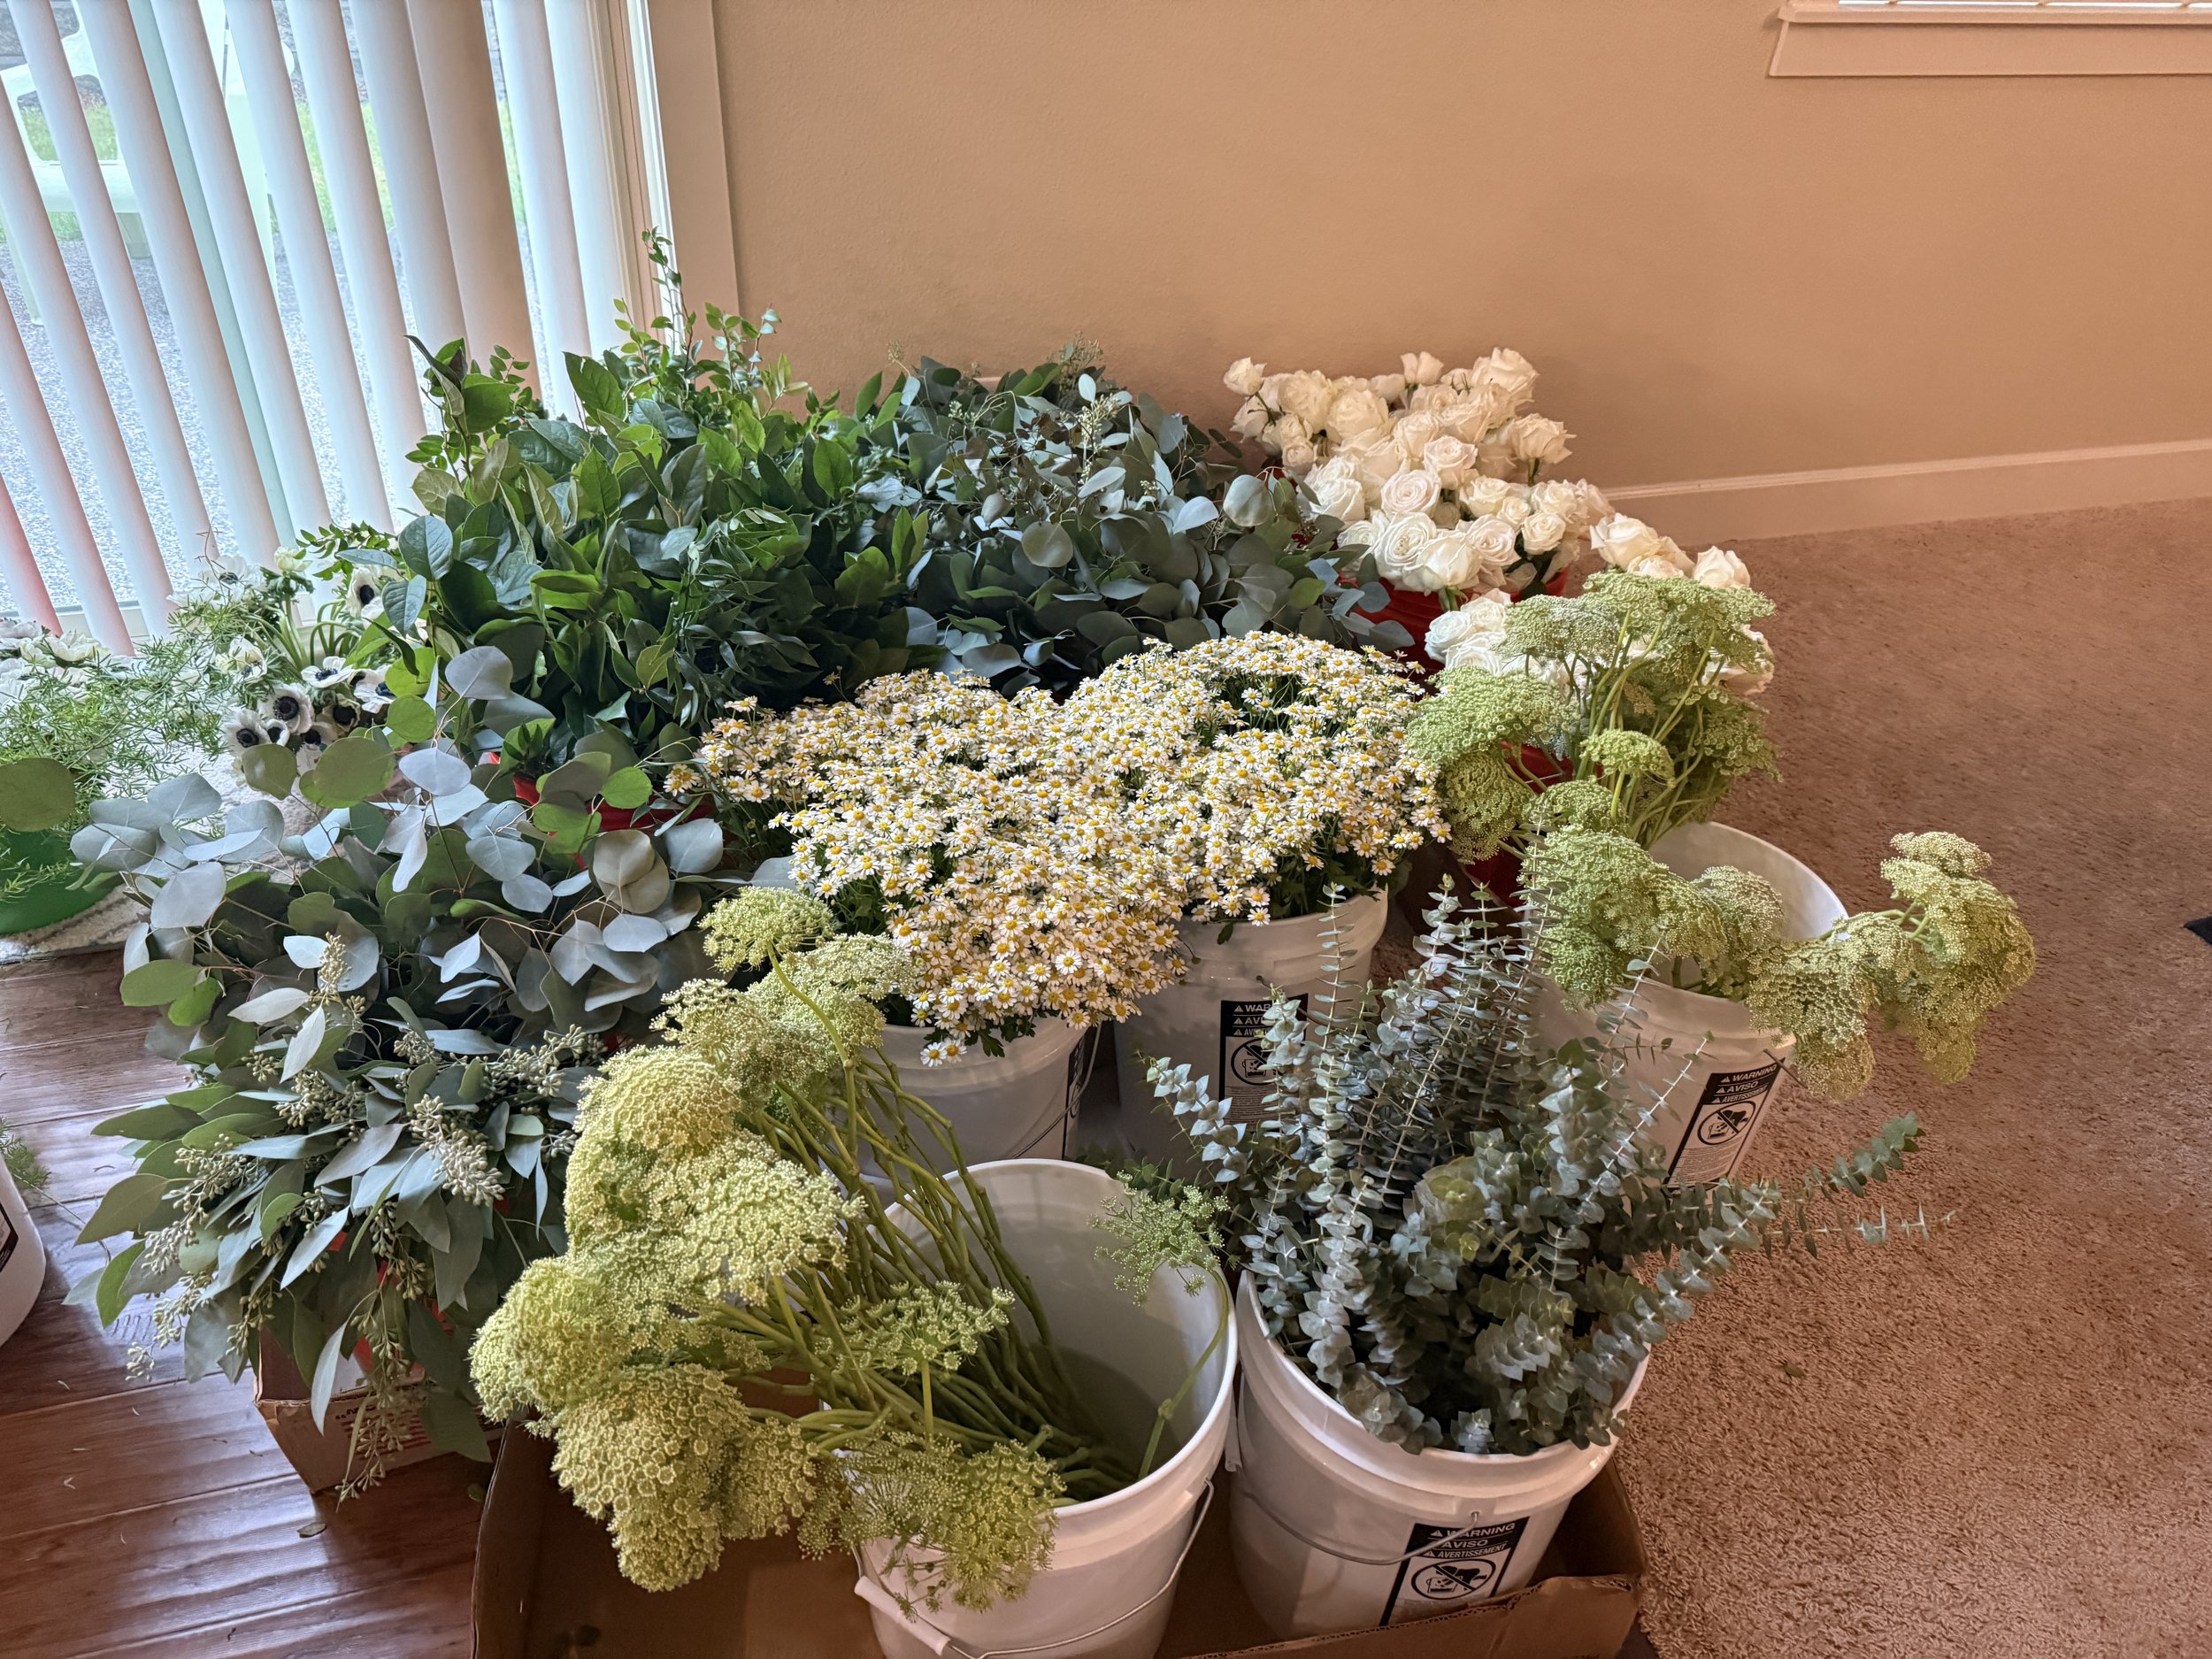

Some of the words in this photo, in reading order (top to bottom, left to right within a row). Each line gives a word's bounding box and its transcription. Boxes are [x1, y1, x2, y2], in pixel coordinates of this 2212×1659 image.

[1732, 1064, 1778, 1081] WARNING
[1726, 1080, 1759, 1094] AVISO
[1437, 1542, 1507, 1558] AVERTISSEMENT
[1440, 1539, 1488, 1548] AVISO
